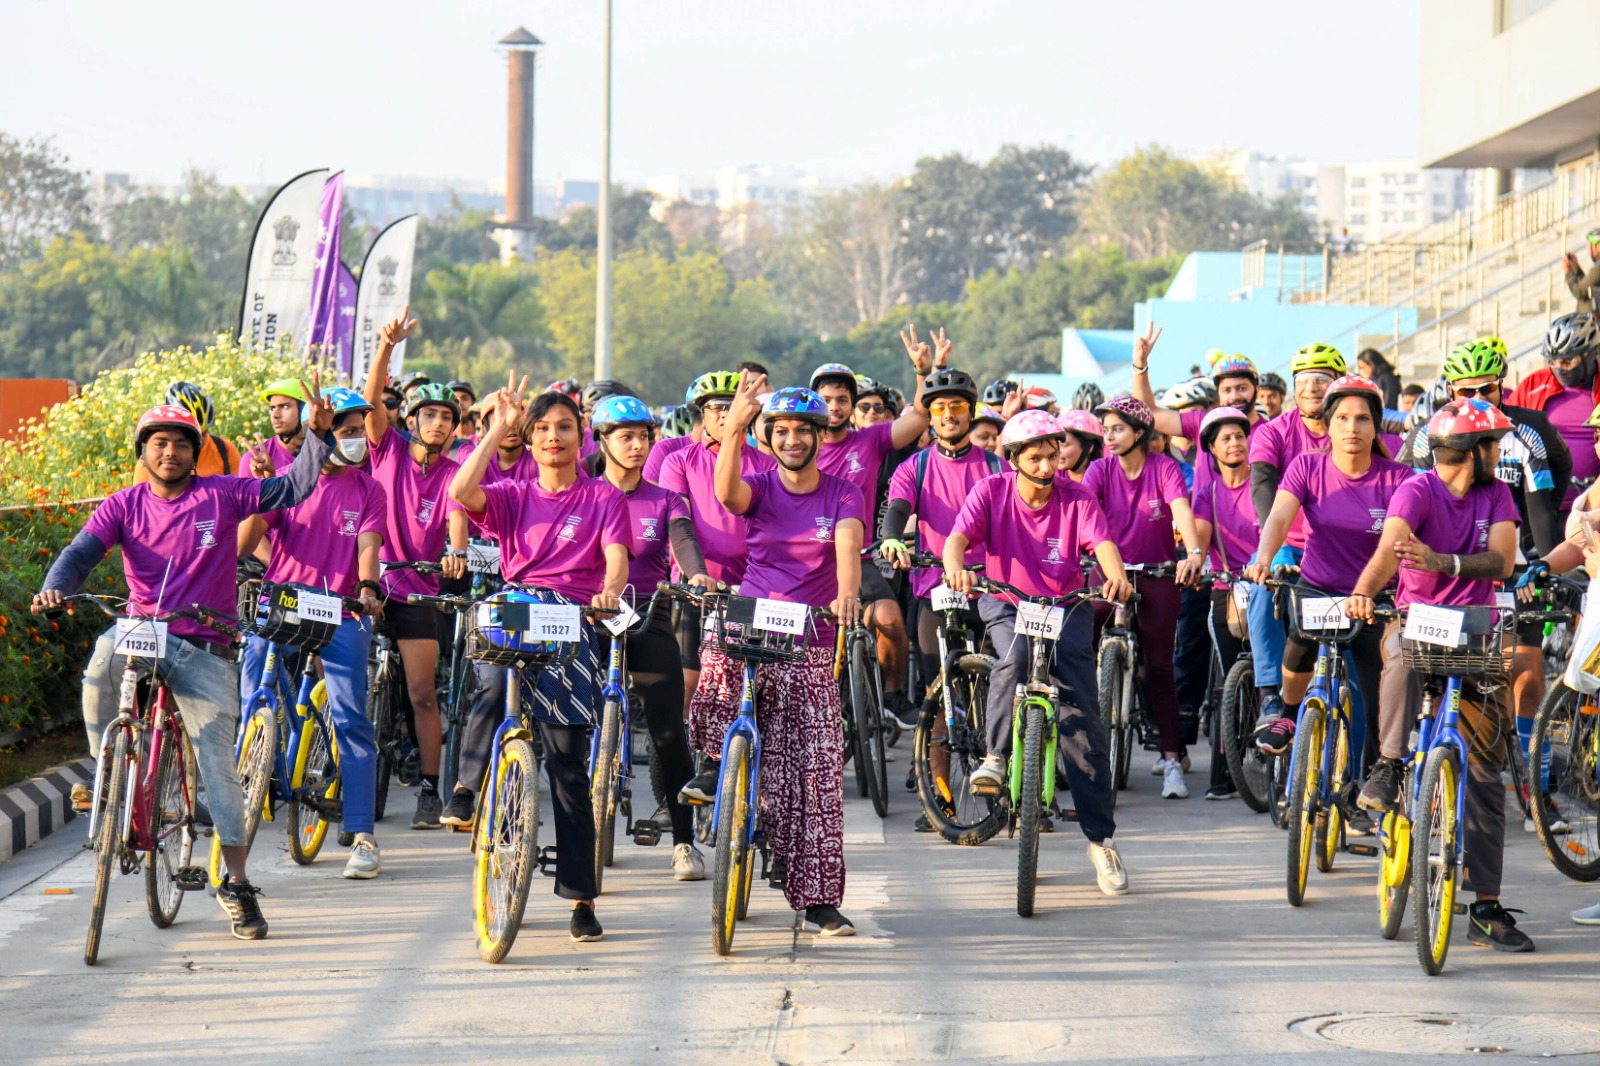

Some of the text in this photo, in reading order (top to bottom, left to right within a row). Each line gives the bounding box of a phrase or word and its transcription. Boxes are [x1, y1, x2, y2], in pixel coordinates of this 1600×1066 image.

[254, 292, 264, 312] OF
[264, 313, 277, 351] TION
[307, 607, 333, 619] 11329
[766, 616, 795, 628] 11324
[1026, 620, 1053, 633] 11325
[541, 624, 570, 636] 11327
[1418, 624, 1450, 639] 11323
[126, 640, 156, 652] 11326
